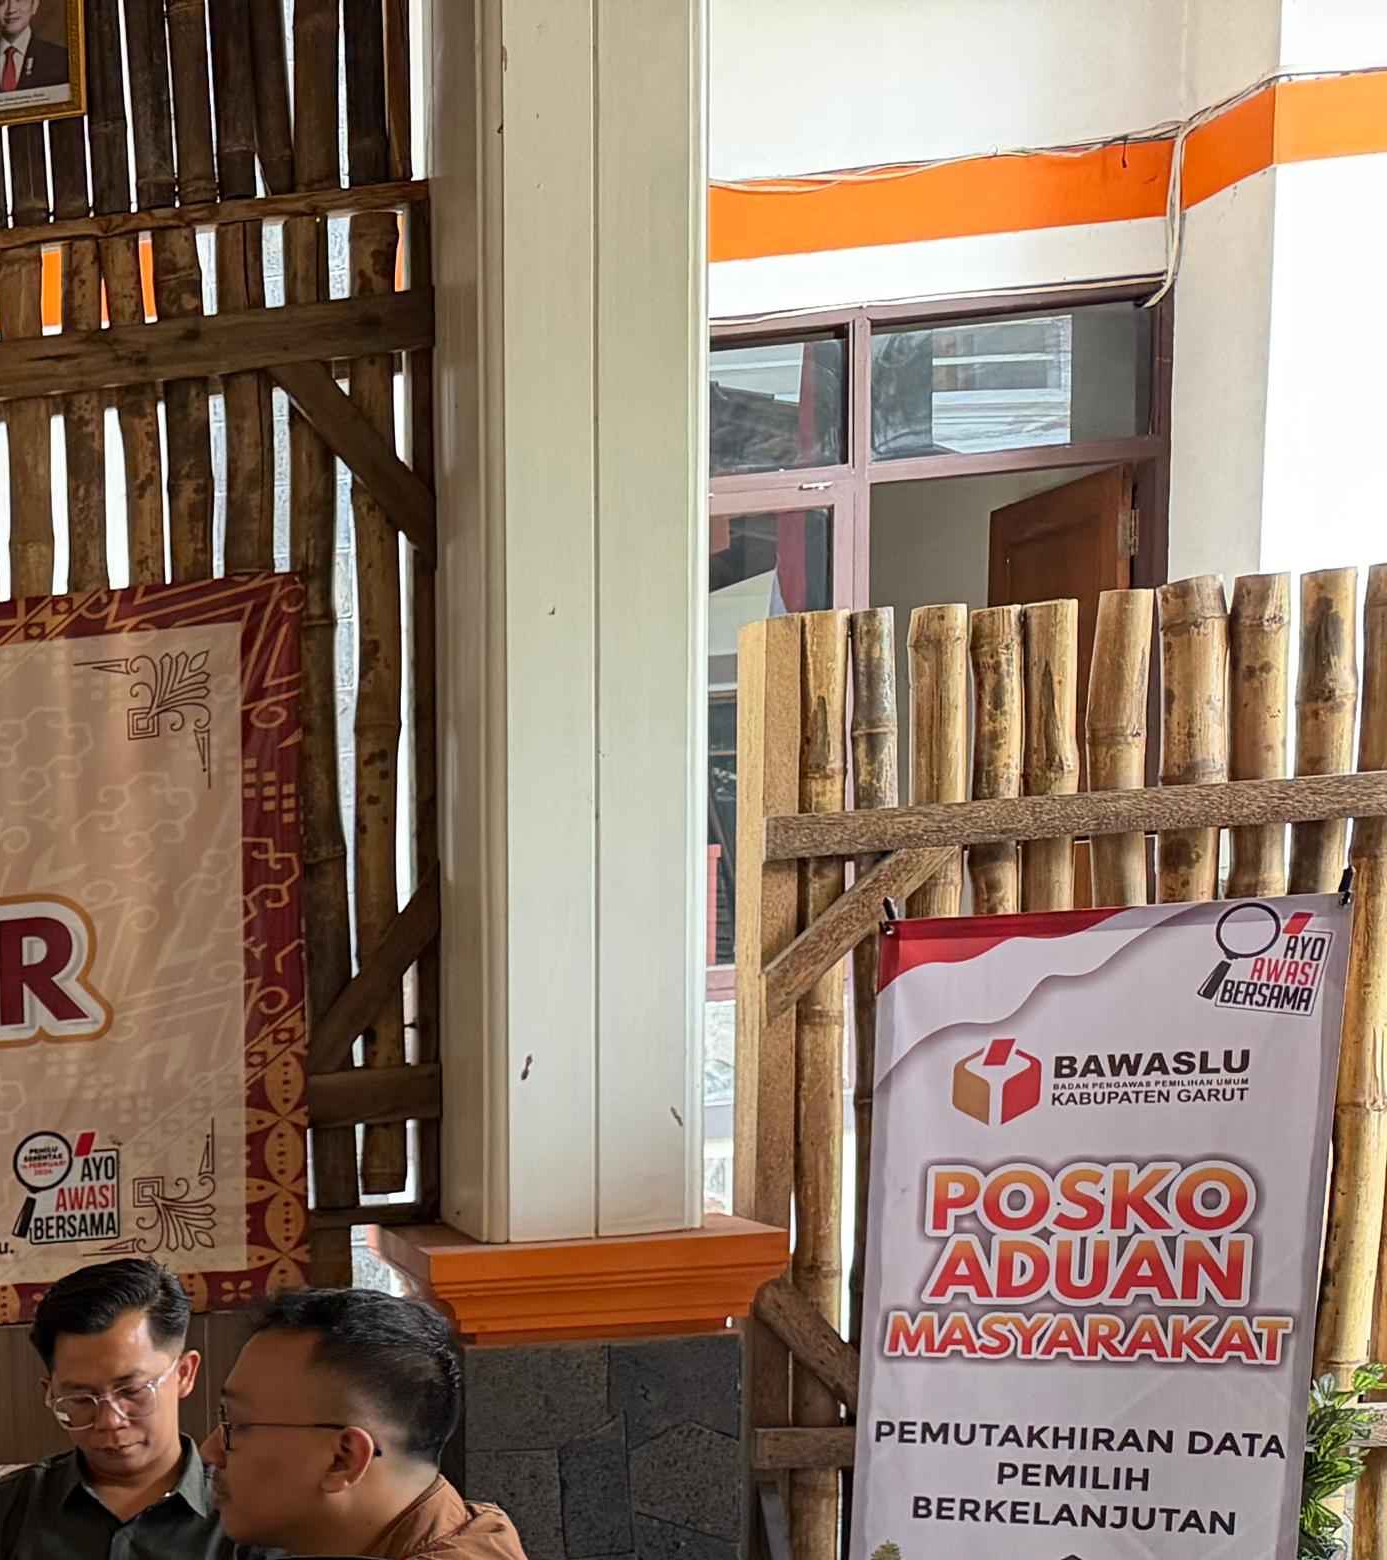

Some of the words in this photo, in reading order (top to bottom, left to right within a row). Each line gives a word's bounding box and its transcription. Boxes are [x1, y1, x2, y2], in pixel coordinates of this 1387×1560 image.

[1283, 935, 1326, 962] AYO
[1250, 957, 1320, 987] AWASI
[1219, 979, 1313, 1012] BERSAMA
[1053, 1049, 1251, 1079] BAWASLU
[1051, 1089, 1171, 1107] KABUPATEN
[1176, 1087, 1249, 1103] GARUT
[1053, 1082, 1089, 1091] BADAN
[1091, 1081, 1152, 1090] PENGAWAS
[1154, 1079, 1213, 1088] PEMILIHAN
[1216, 1078, 1249, 1086] UMUM
[81, 1155, 115, 1182] AYO
[55, 1184, 115, 1213] AWASI
[929, 1163, 1251, 1234] POSKO
[33, 1211, 117, 1240] BERSAMA
[926, 1236, 1245, 1303] ADUAN
[886, 1315, 1291, 1363] MASYARAKAT
[874, 1420, 1175, 1456] PEMUTAKHIRAN
[1187, 1429, 1286, 1459] DATA
[996, 1462, 1150, 1492] PEMILIH
[912, 1497, 1237, 1536] BERKELANJUTAN
